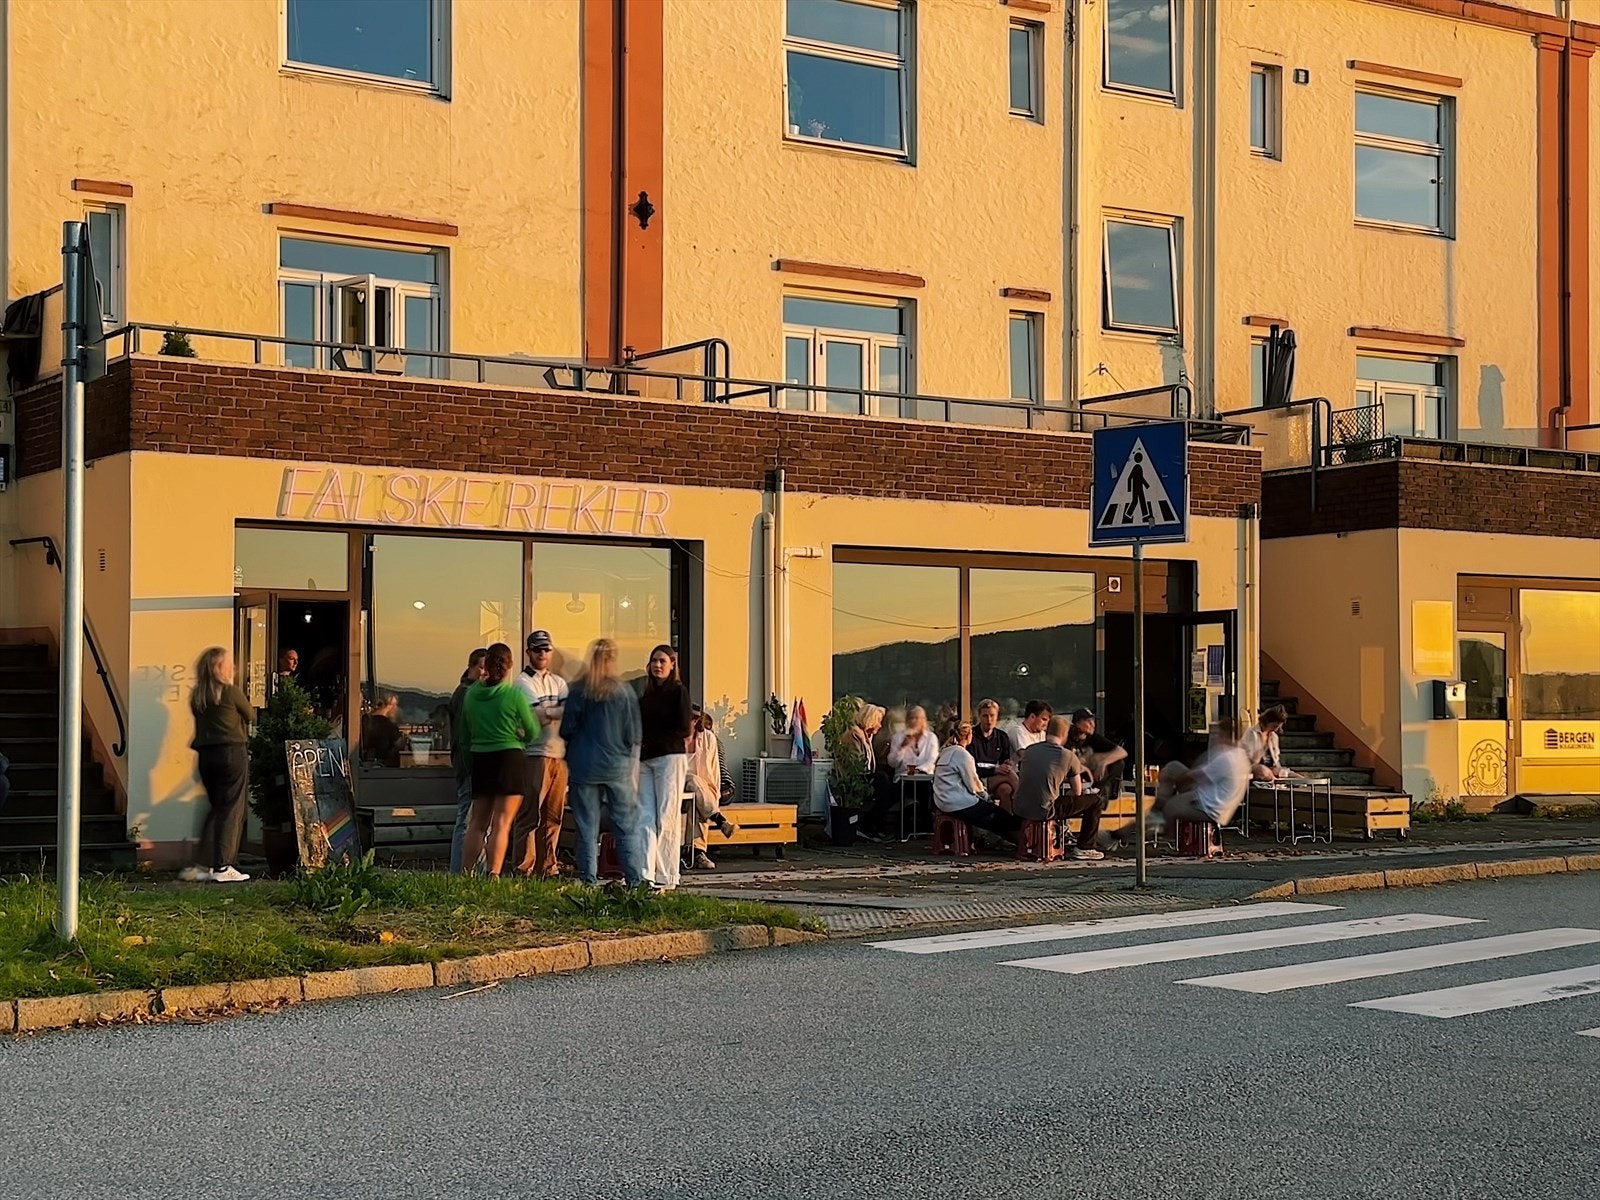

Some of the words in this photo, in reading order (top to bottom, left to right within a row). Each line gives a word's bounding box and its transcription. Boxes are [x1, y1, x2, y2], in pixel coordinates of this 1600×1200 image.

[281, 467, 492, 528] FALSKE
[505, 479, 672, 536] REKER
[1559, 731, 1595, 743] BERGEN
